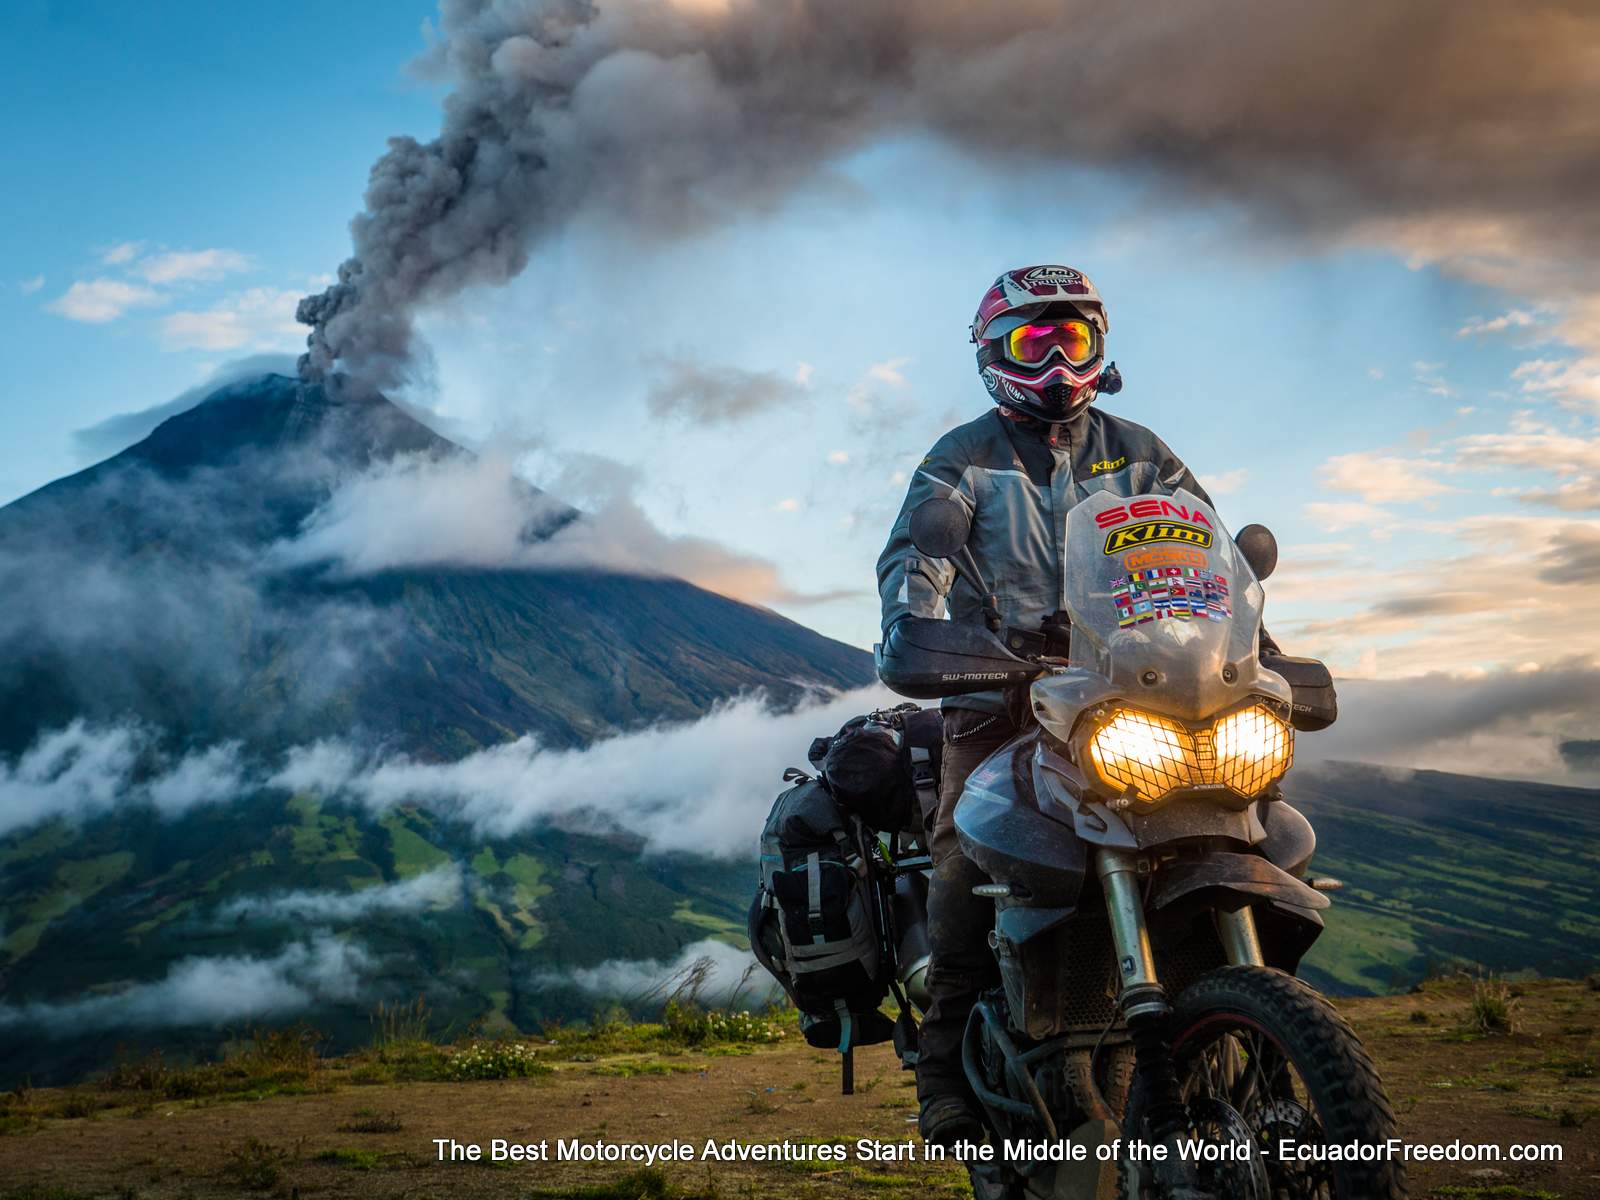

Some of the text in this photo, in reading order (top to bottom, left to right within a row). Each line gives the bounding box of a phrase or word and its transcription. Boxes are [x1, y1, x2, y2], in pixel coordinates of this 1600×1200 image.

[1036, 268, 1073, 278] Arai
[1029, 279, 1082, 287] TRIUMPH
[1091, 457, 1126, 474] Klim
[1095, 500, 1214, 529] SENA
[1113, 523, 1206, 548] Klim
[942, 672, 1009, 681] SW-MOTECH
